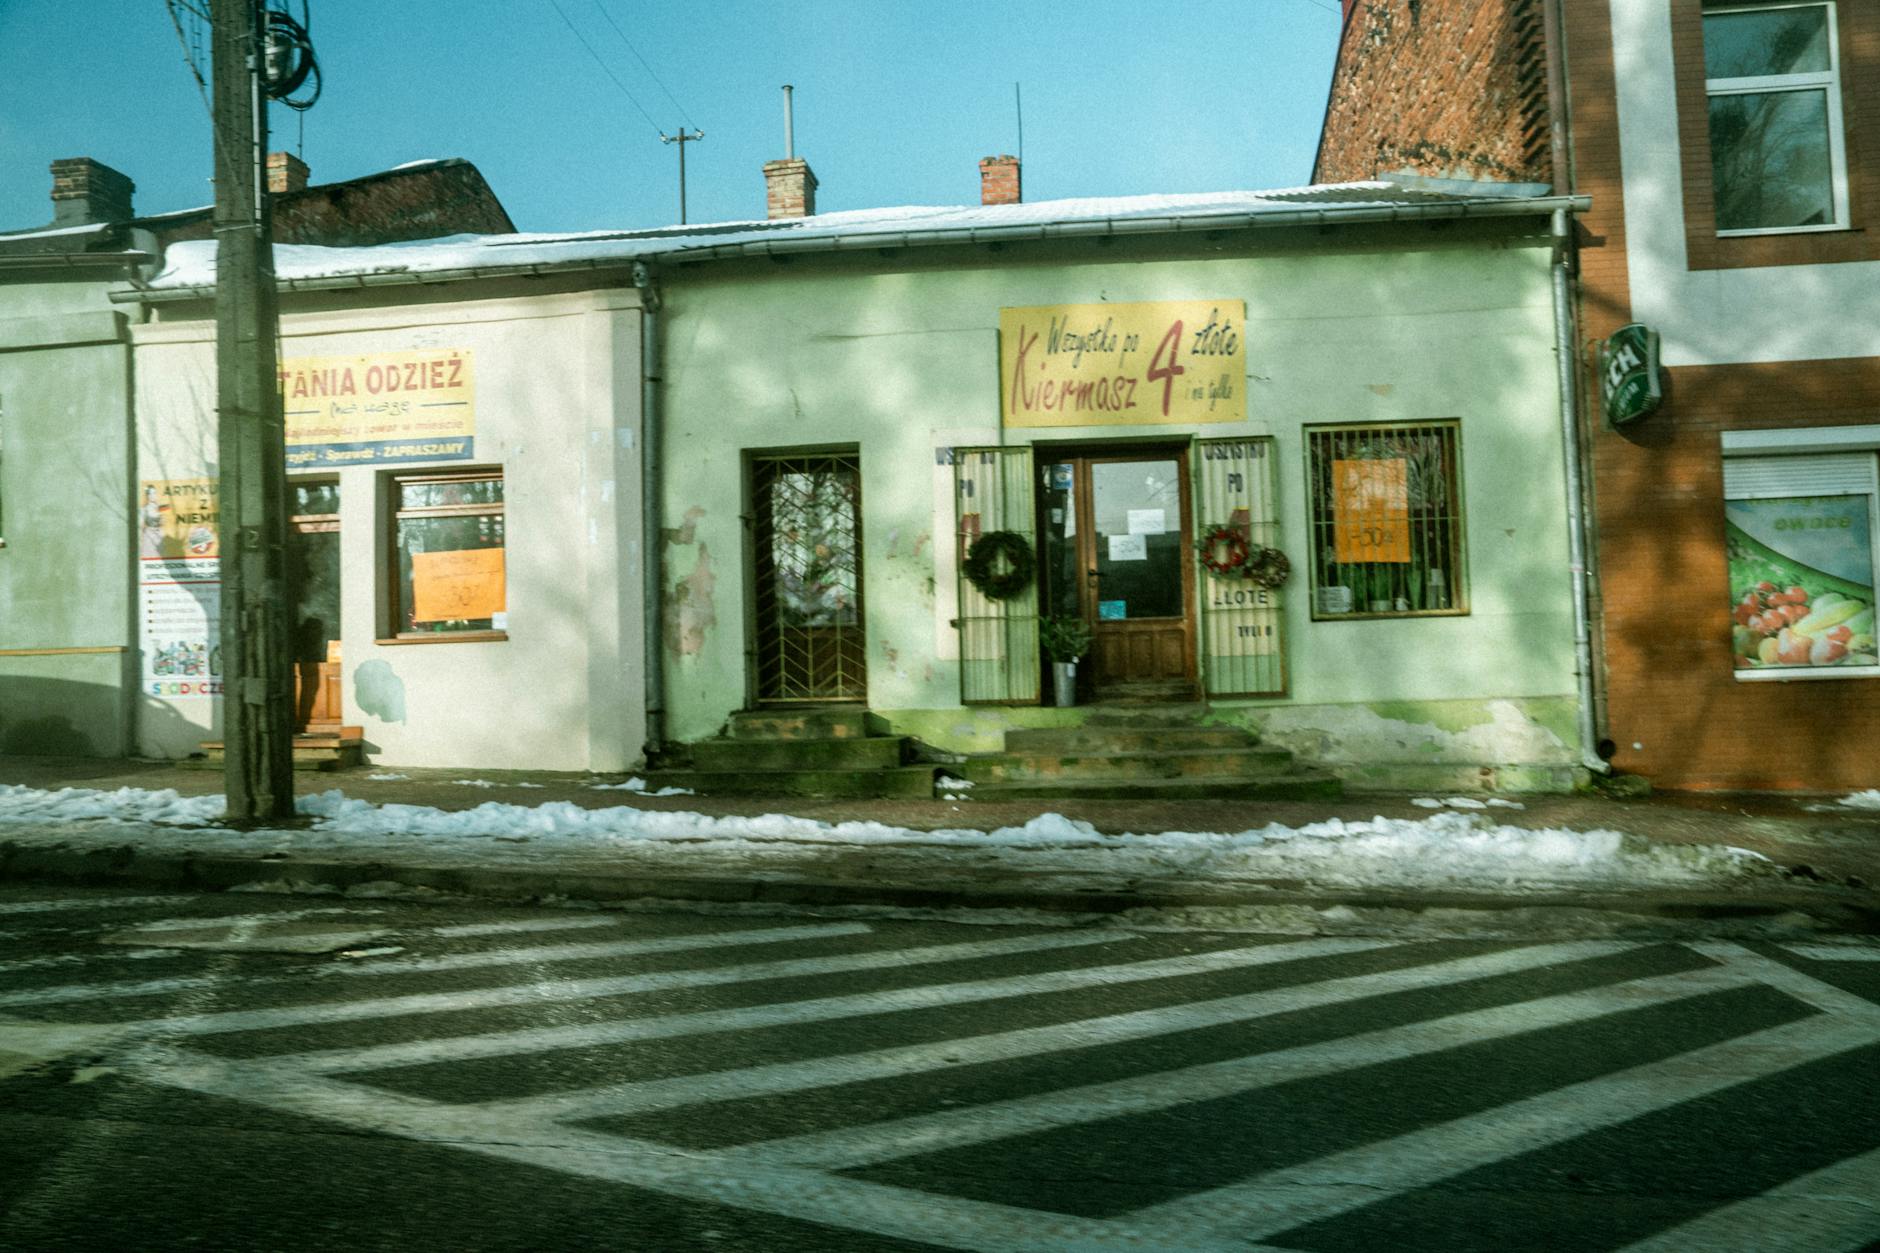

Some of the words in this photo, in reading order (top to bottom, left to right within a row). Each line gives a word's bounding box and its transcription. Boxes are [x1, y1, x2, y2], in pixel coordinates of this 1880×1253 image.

[277, 366, 357, 398] TANIA
[365, 352, 464, 395] ODZIEŻ
[1011, 324, 1138, 416] Kiermasz
[1119, 332, 1139, 368] po
[1147, 319, 1185, 417] 4
[1190, 306, 1238, 356] złote
[384, 442, 465, 458] ZAPRASZAMY
[200, 499, 208, 510] Z
